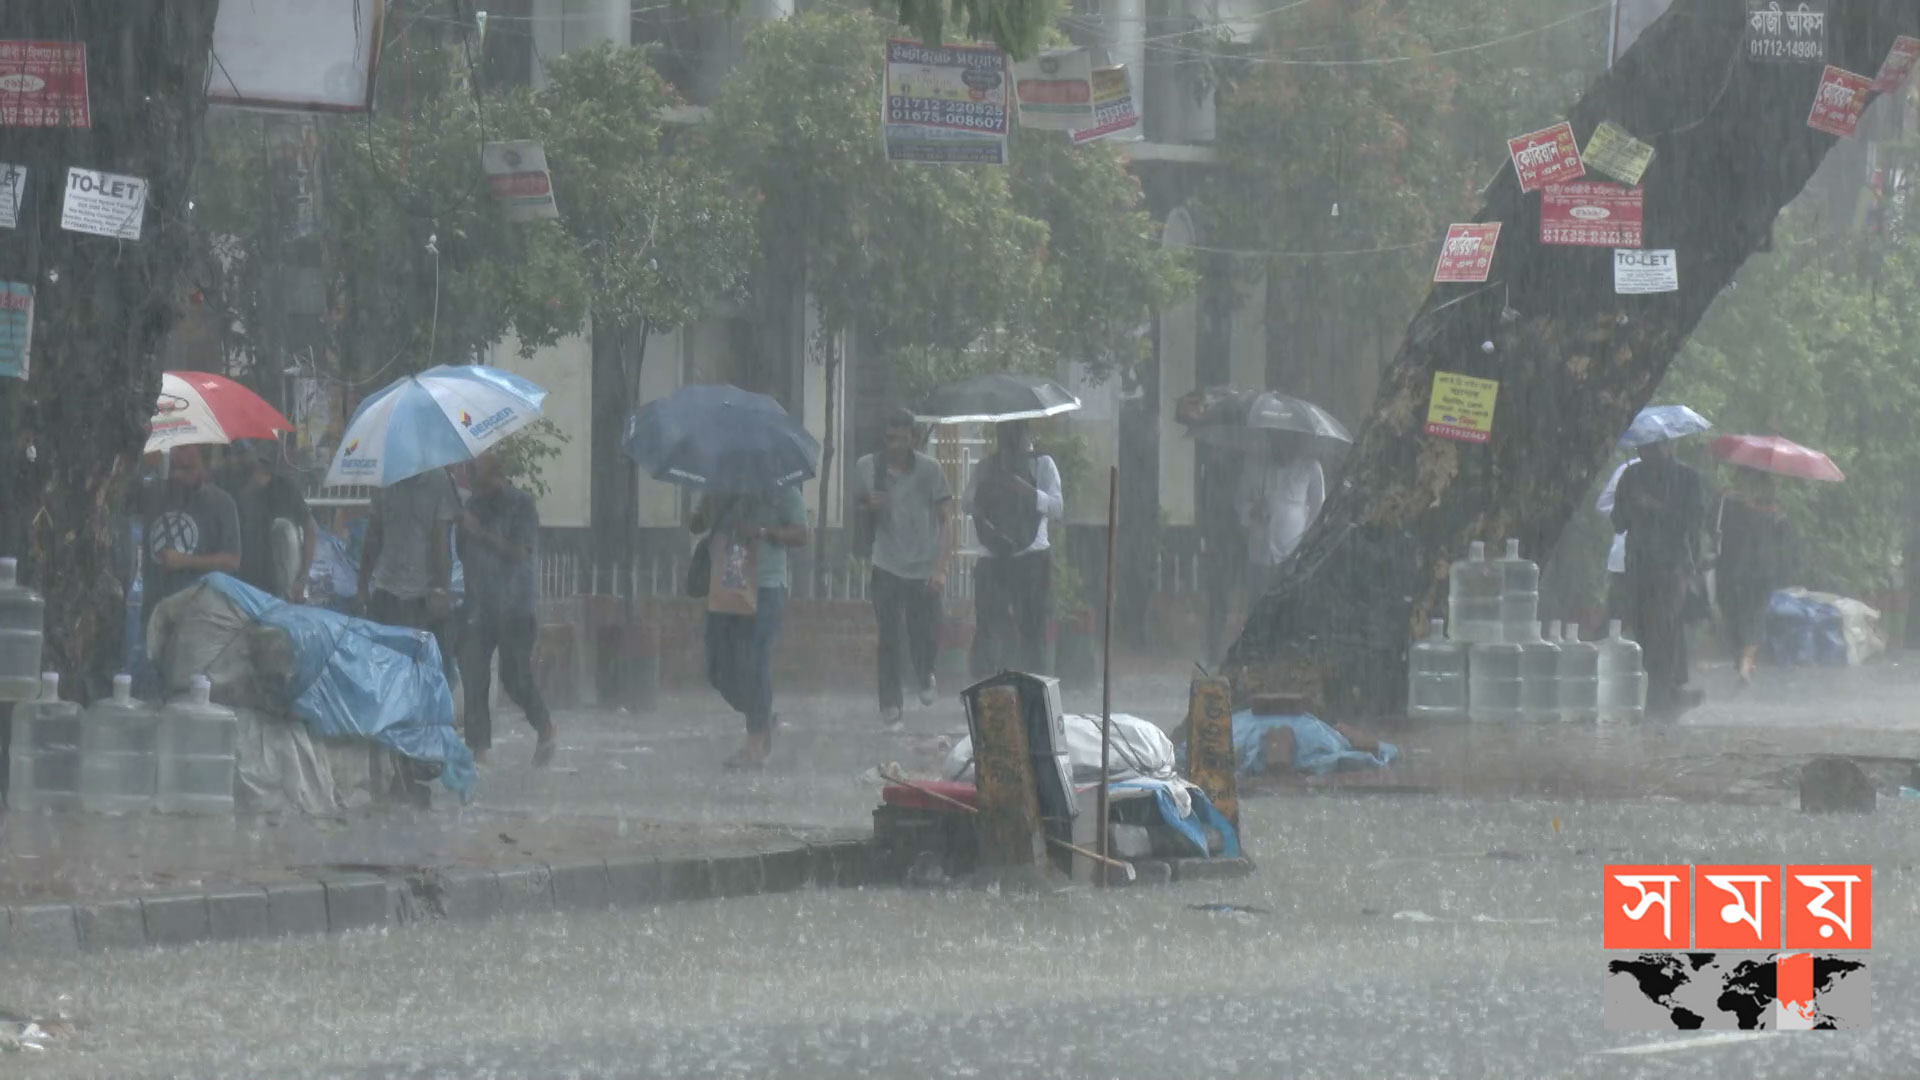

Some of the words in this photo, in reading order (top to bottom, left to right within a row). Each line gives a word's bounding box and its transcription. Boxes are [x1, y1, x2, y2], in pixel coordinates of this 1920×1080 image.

[1750, 1, 1783, 36] কাজী
[1786, 3, 1824, 37] অফিস
[1515, 140, 1561, 171] কোরিয়ান
[70, 173, 140, 200] TO-LET
[1616, 253, 1669, 266] TO-LET
[469, 406, 514, 437] BERGER
